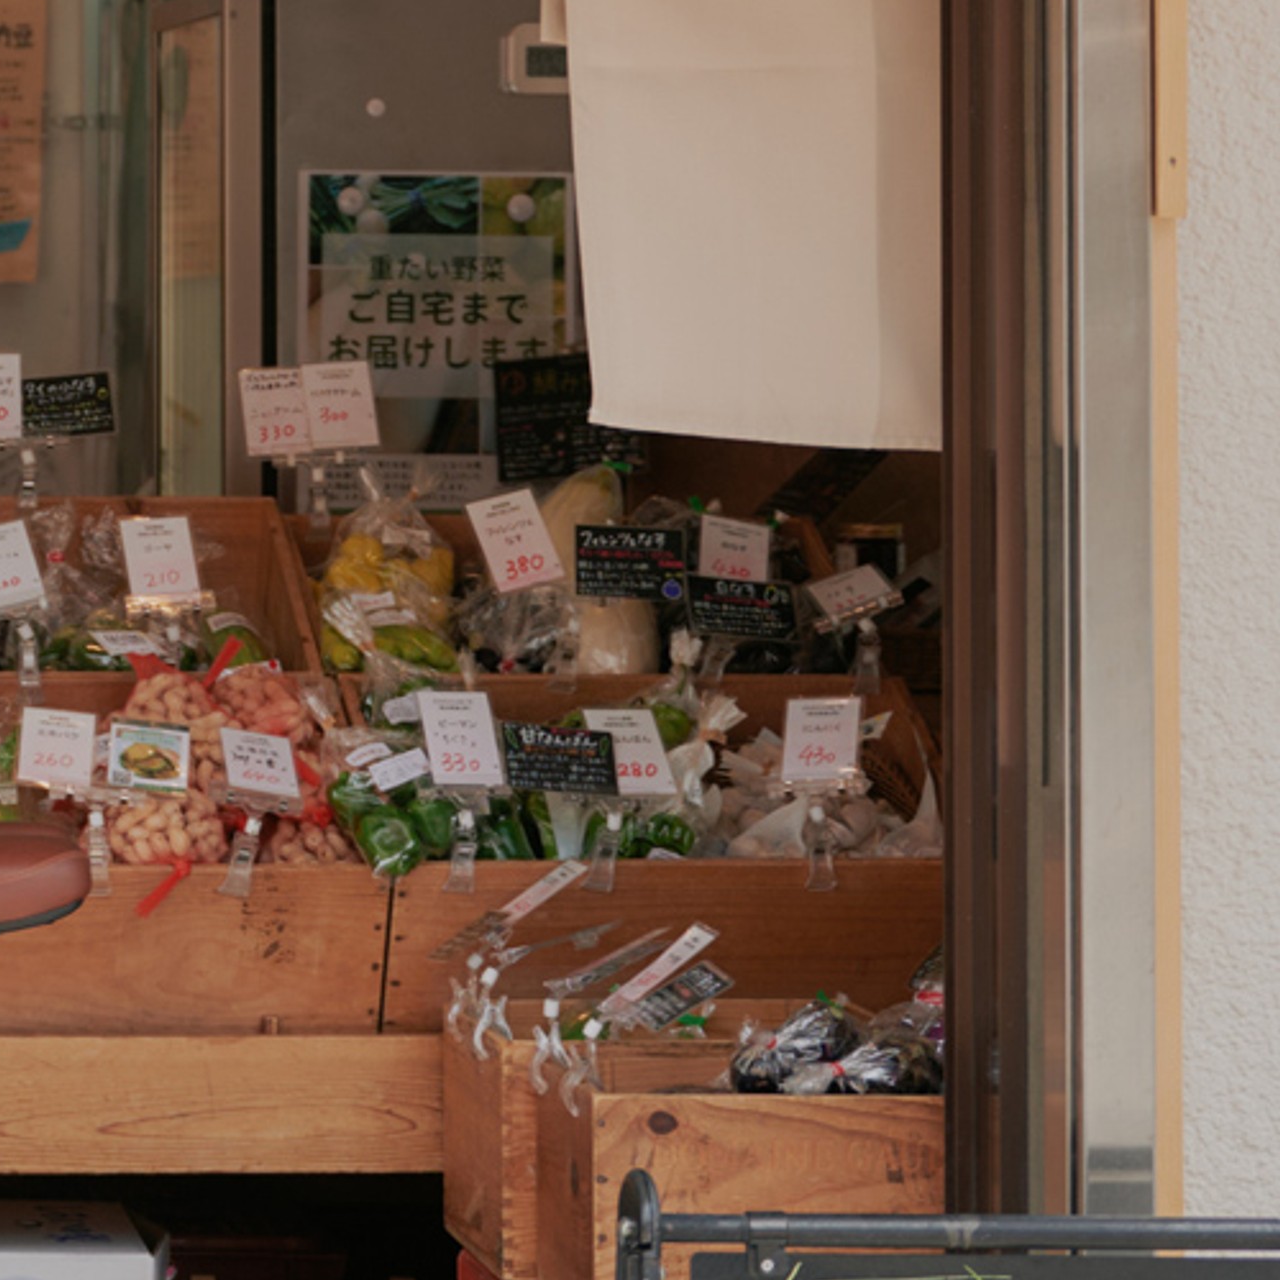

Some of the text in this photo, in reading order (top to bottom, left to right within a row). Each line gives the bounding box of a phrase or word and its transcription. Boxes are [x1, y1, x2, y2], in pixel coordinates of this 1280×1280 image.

[369, 254, 507, 283] 重たい野菜
[348, 290, 529, 326] ご自宅まで
[327, 334, 548, 370] お届けします
[320, 406, 349, 424] 300
[259, 424, 296, 444] 330
[505, 553, 545, 580] 380
[142, 568, 181, 587] 210
[32, 751, 75, 768] 260
[442, 751, 480, 772] 330
[617, 761, 659, 778] 280
